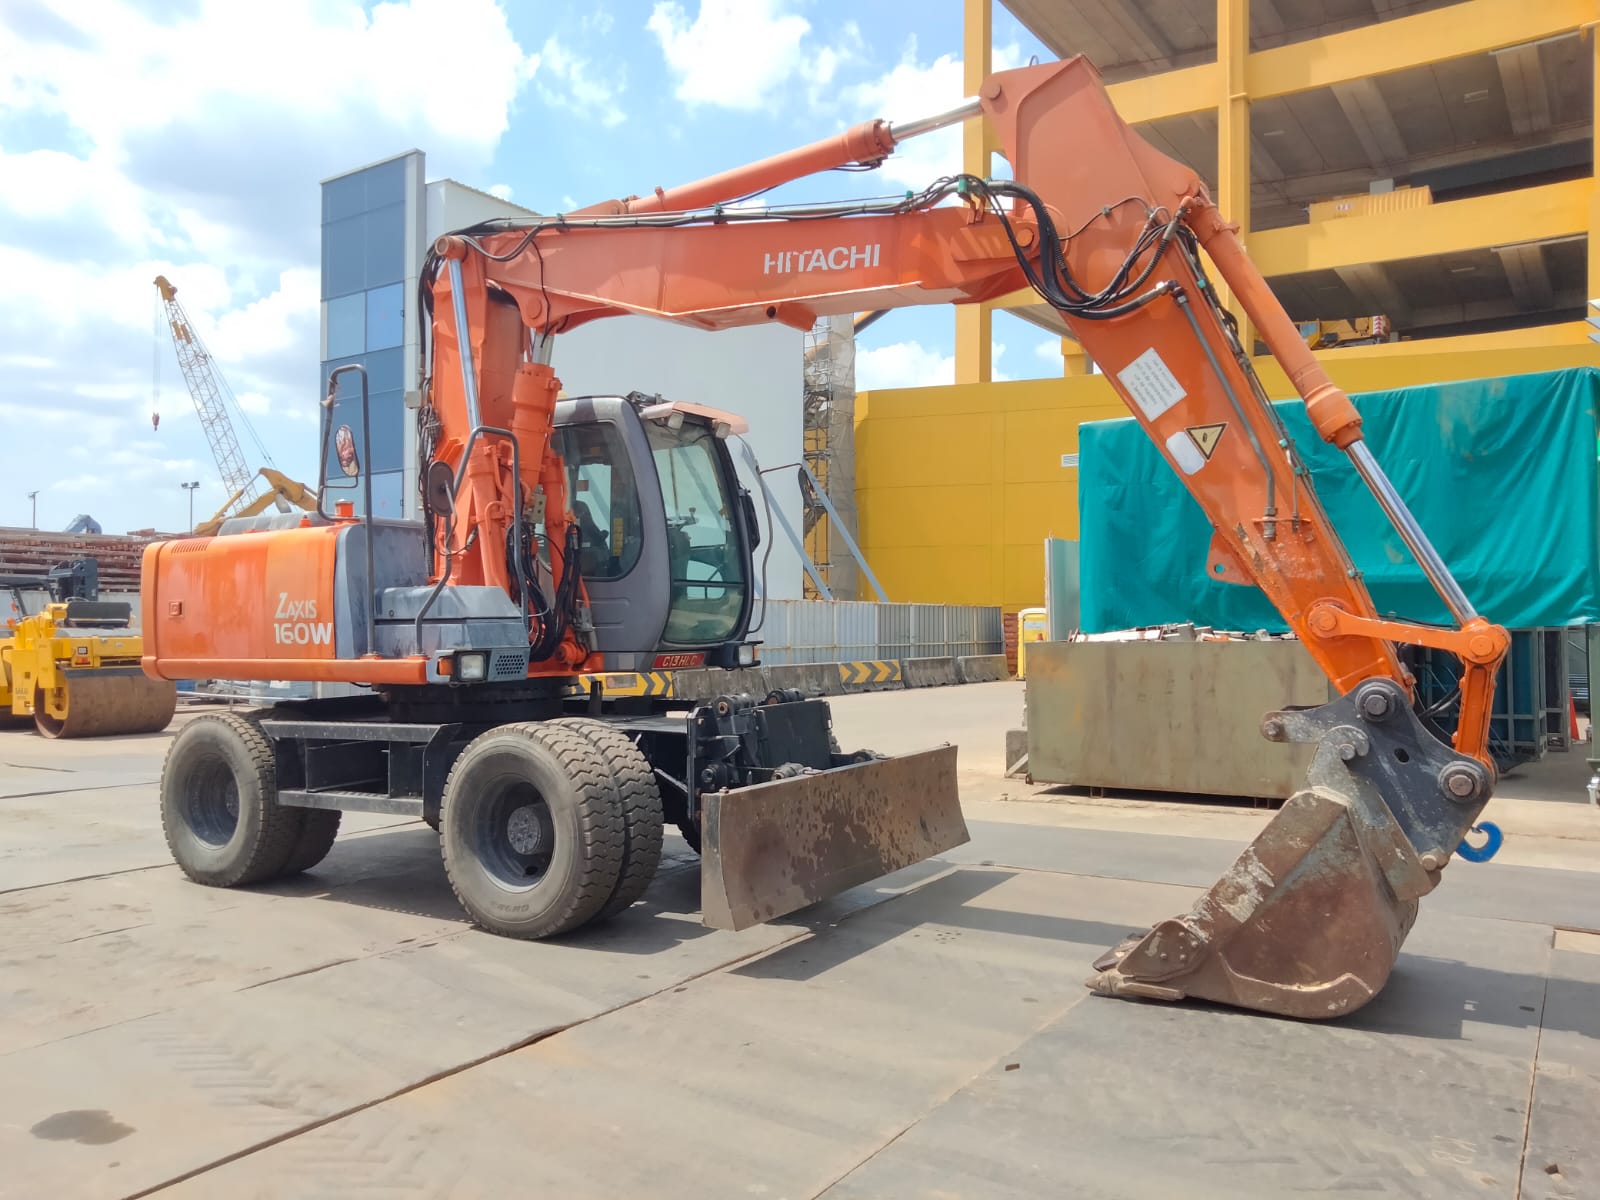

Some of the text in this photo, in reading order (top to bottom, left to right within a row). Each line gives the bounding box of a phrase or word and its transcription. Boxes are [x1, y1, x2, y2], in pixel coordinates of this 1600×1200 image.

[764, 244, 881, 274] HITACHI
[274, 592, 318, 621] ZAXIS
[274, 623, 333, 645] 160W
